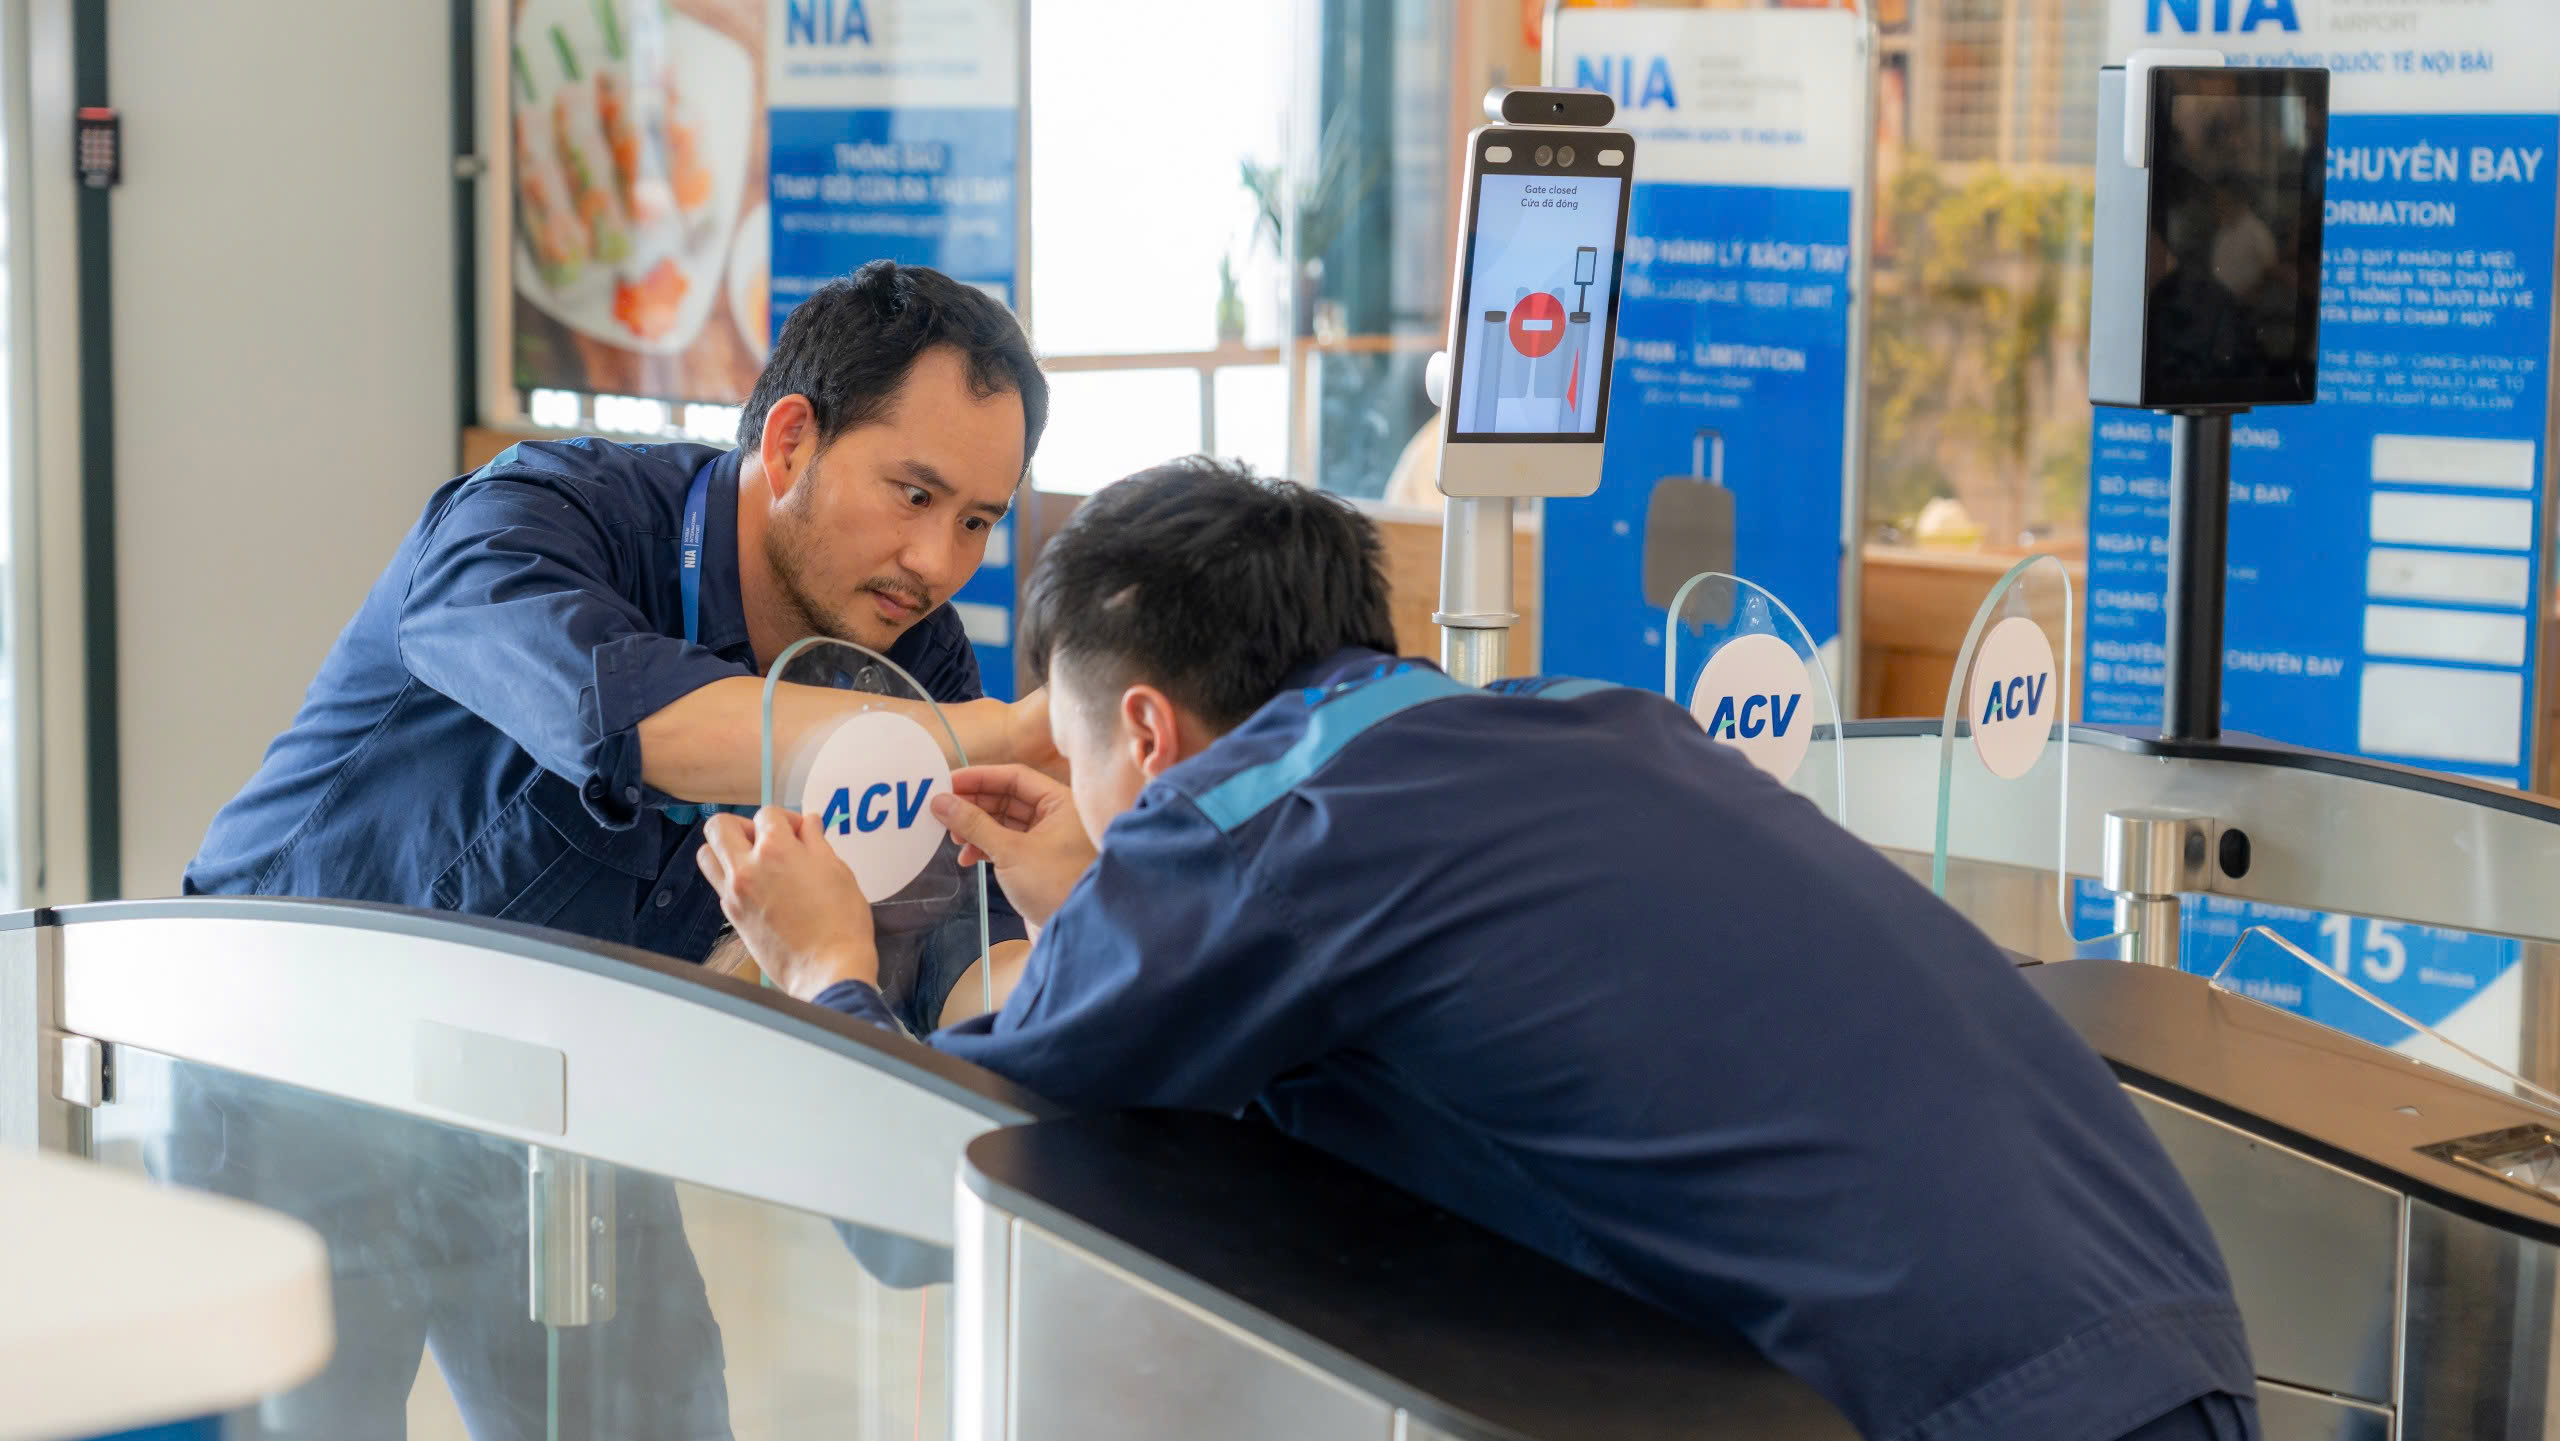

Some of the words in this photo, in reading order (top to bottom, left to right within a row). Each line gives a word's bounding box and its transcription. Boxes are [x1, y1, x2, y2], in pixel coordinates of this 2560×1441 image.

[785, 0, 873, 45] NIA
[2145, 0, 2300, 34] NIA
[1576, 56, 1678, 110] NIA
[2470, 147, 2543, 183] BAY
[1525, 184, 1547, 195] Gate
[1548, 183, 1578, 196] closed
[2323, 201, 2456, 227] ORMATION
[684, 549, 697, 569] NIA
[2305, 655, 2345, 678] BAY
[1707, 693, 1802, 740] ACV
[1982, 672, 2048, 726] ACV
[823, 777, 935, 836] ACV
[2319, 914, 2407, 985] 15
